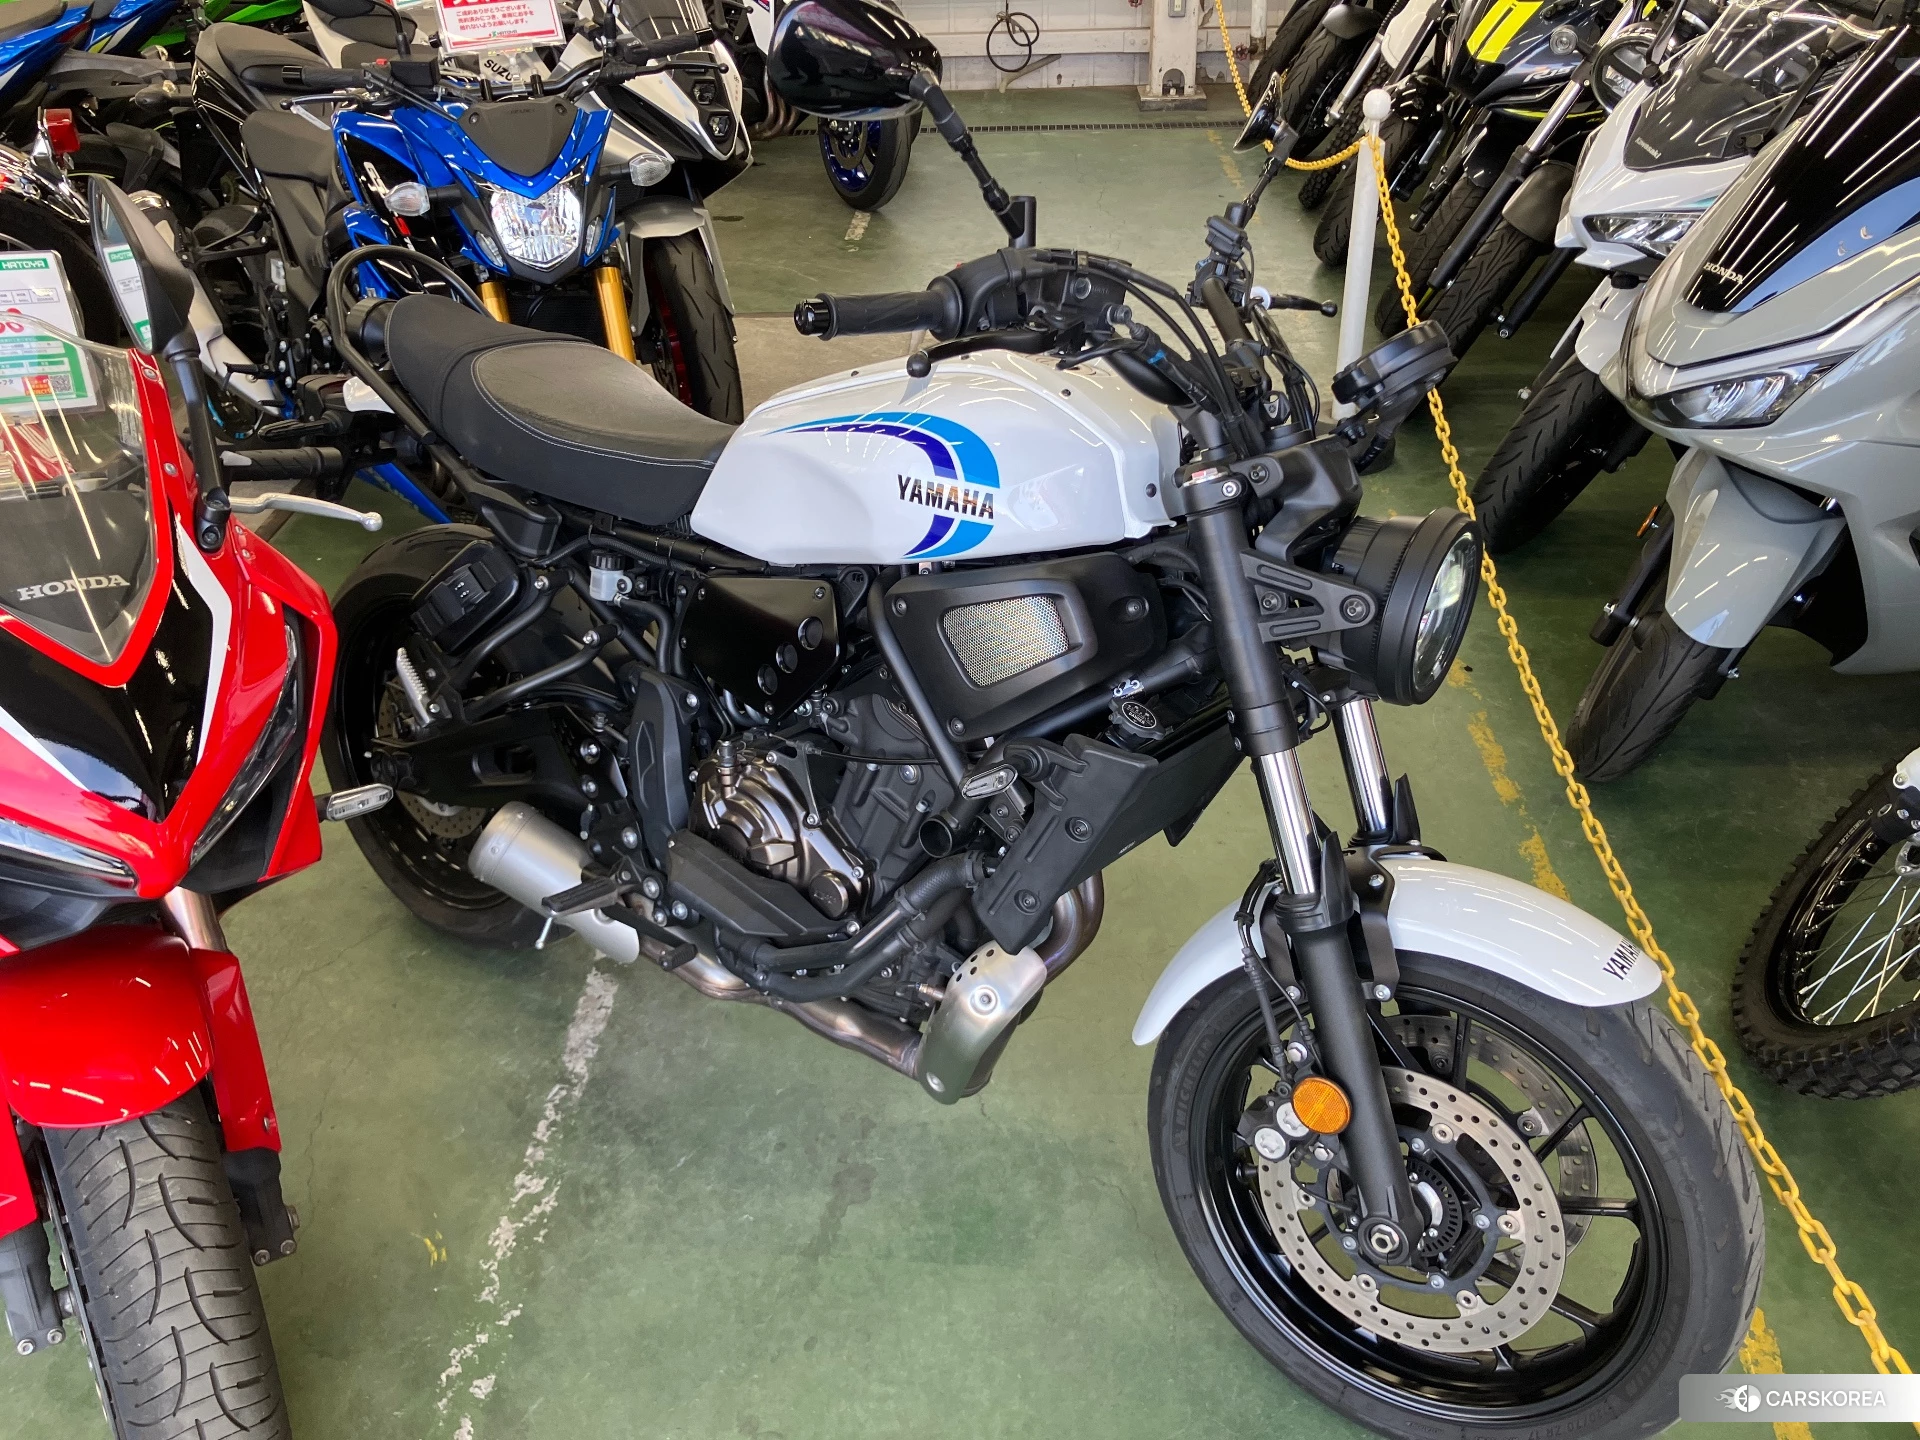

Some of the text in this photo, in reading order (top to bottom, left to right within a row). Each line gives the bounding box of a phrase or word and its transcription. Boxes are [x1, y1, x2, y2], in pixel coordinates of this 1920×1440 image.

[484, 59, 513, 82] SUZU
[1, 260, 46, 270] HATOYA
[1703, 261, 1744, 285] HONDA
[897, 473, 994, 520] YAMAHA
[16, 574, 131, 601] HONDA
[1174, 1037, 1212, 1129] MICHELIN
